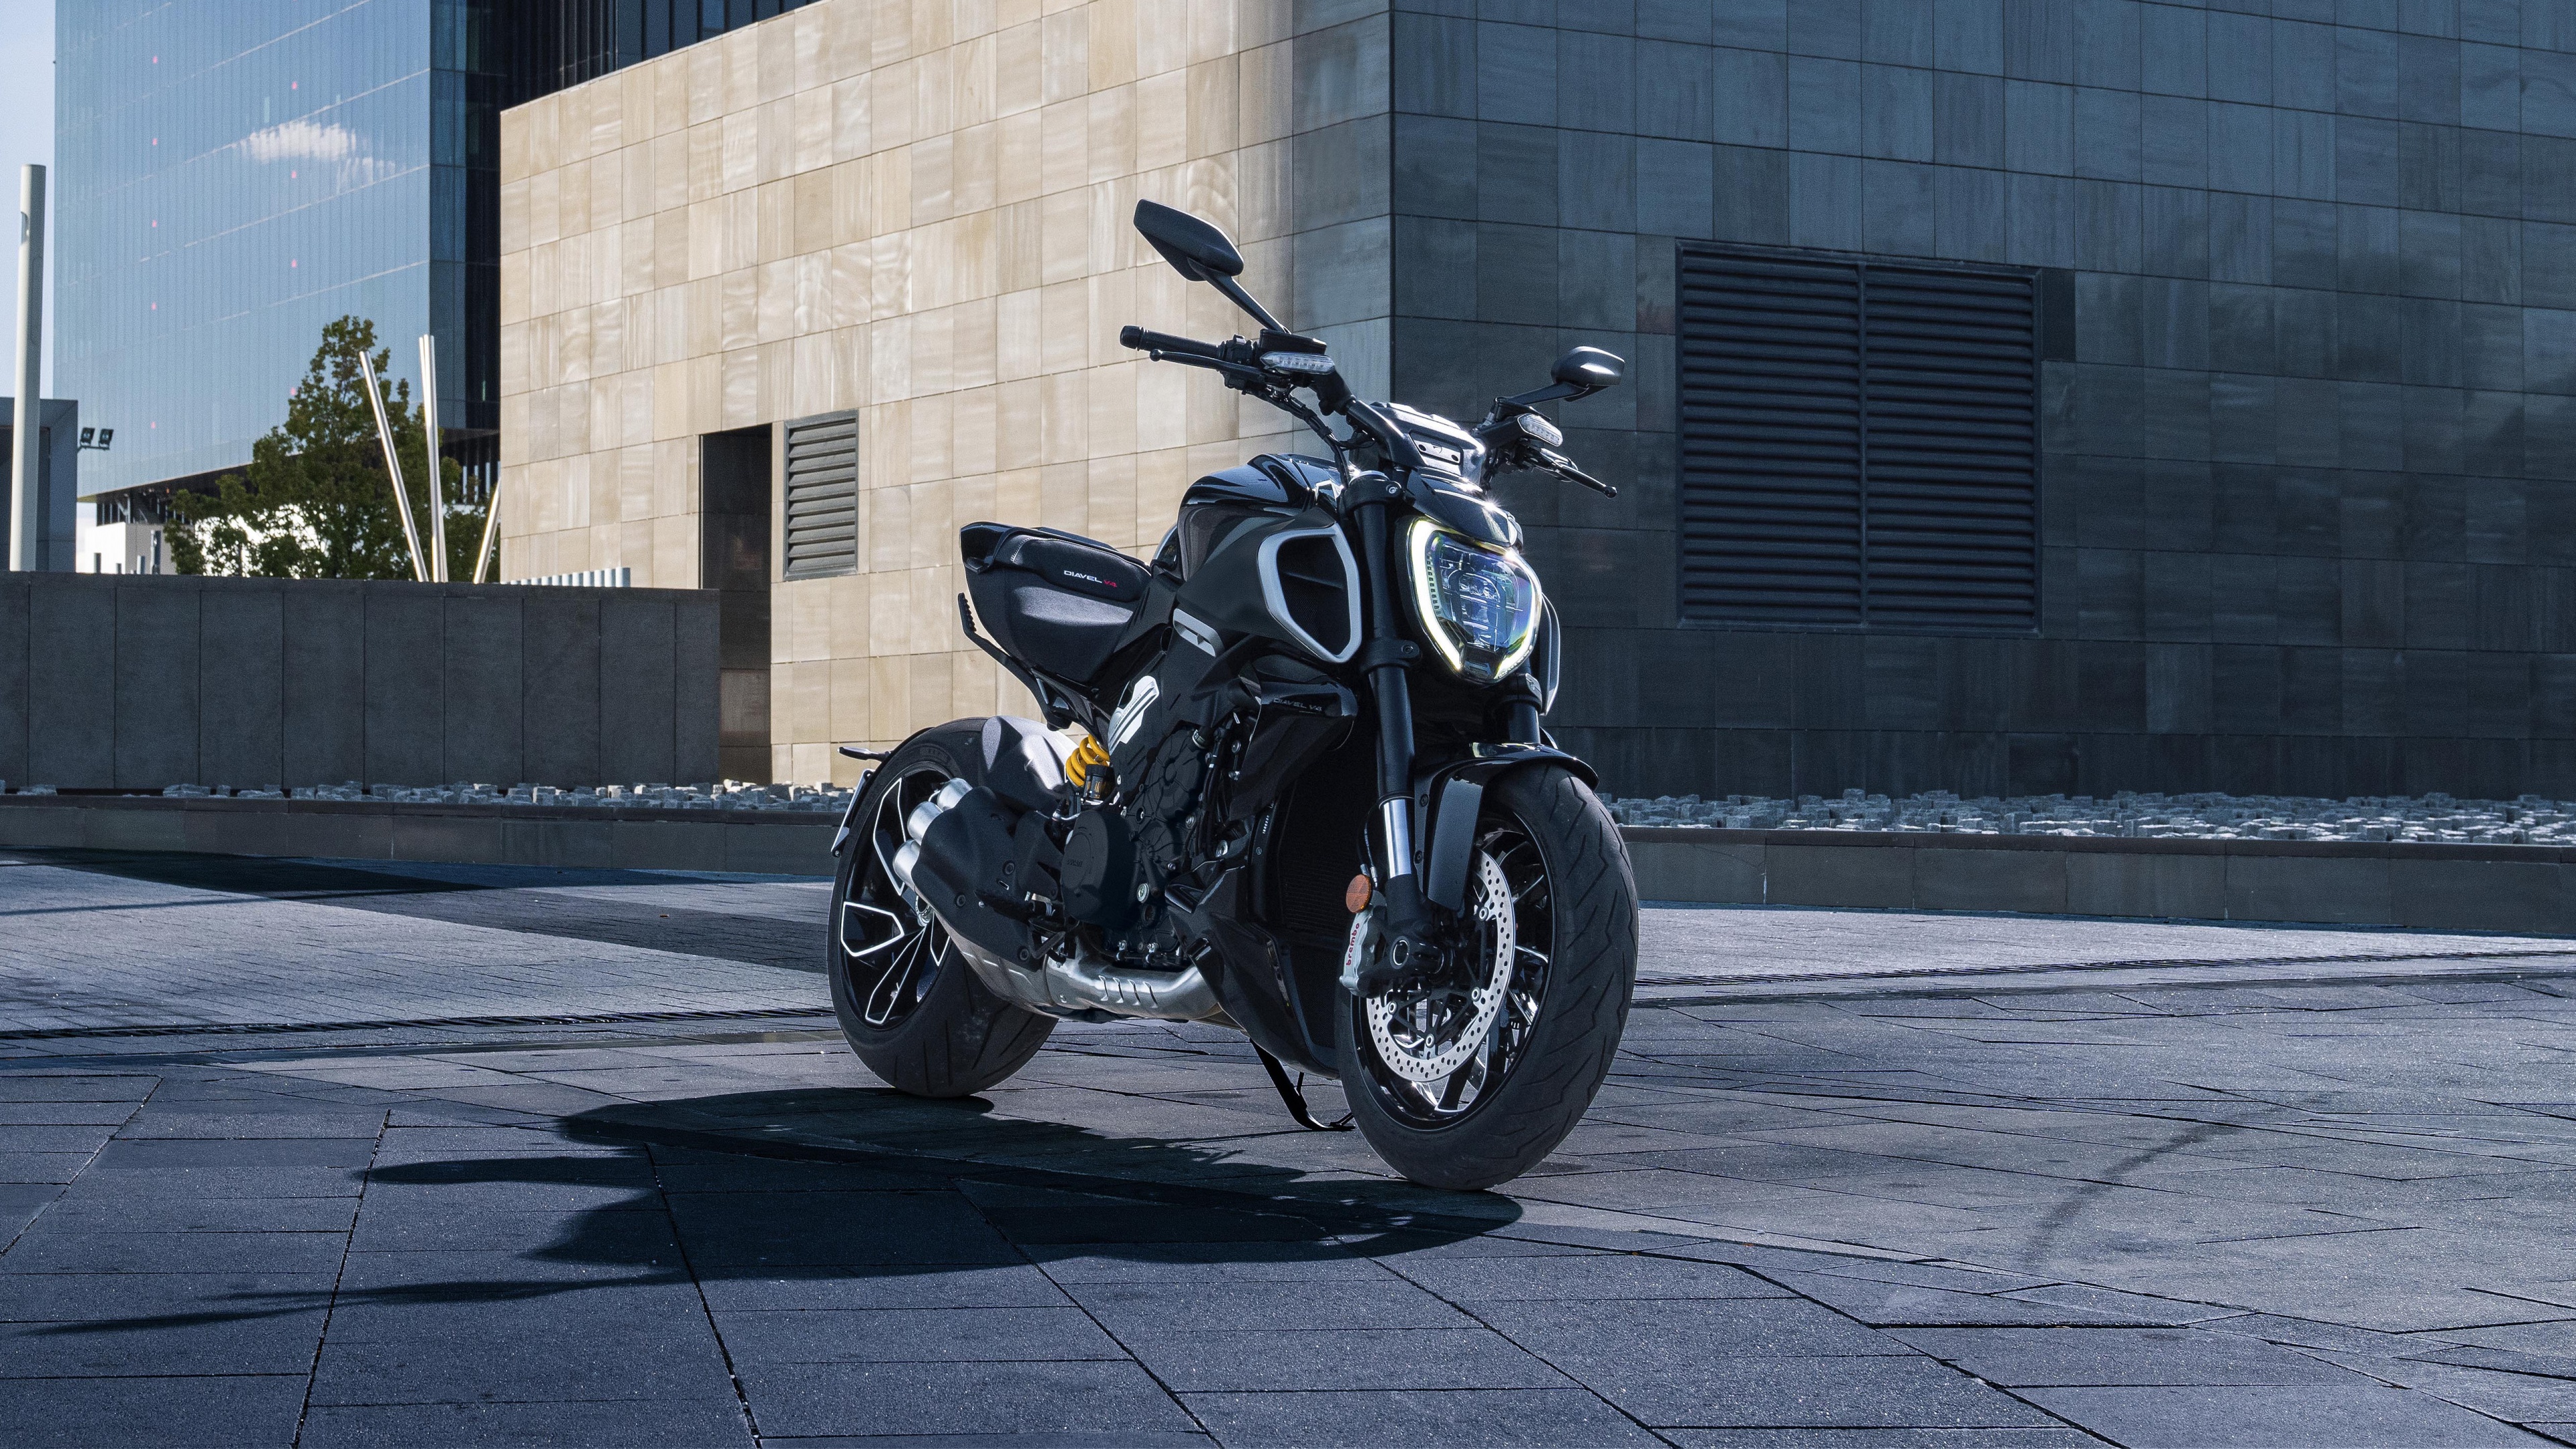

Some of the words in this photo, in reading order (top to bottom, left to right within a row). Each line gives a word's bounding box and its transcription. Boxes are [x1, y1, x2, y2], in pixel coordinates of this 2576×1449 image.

[1064, 570, 1102, 584] DIAVEL
[1104, 580, 1118, 588] V4
[1273, 698, 1307, 709] DIAVEL
[1309, 704, 1322, 712] V4
[1346, 923, 1360, 966] brembo
